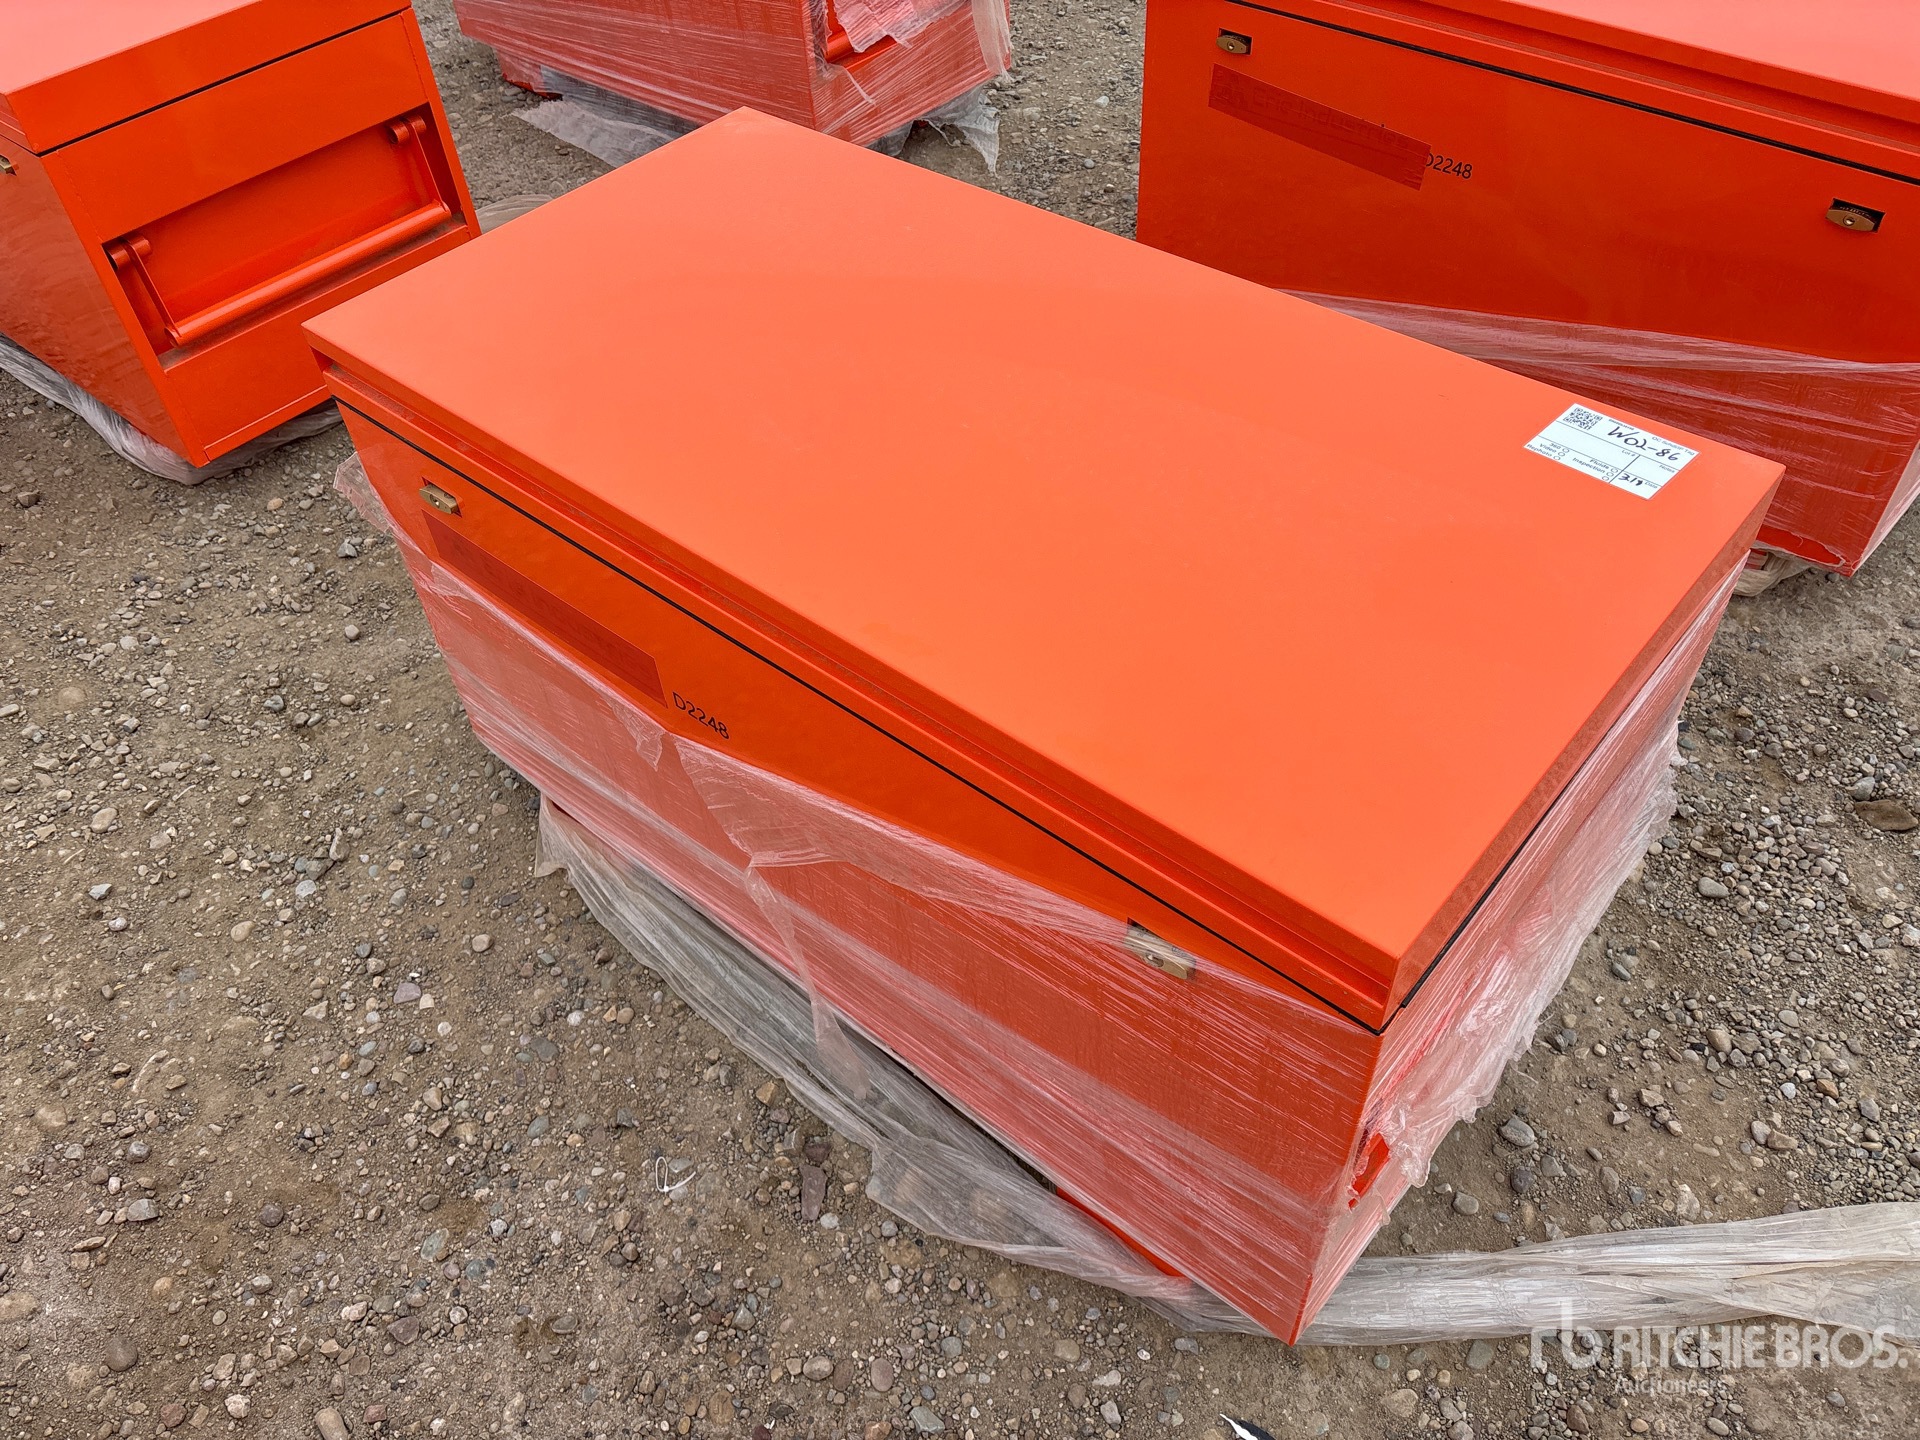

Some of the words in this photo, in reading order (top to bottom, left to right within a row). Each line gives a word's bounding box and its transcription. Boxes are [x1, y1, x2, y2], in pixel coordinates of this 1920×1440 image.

[1526, 443, 1553, 457] Rephoto
[1539, 443, 1557, 453] Video
[1572, 457, 1606, 474] Inspection
[1589, 459, 1610, 470] Fluids
[1659, 464, 1675, 473] Notes
[1644, 481, 1658, 489] Date
[672, 691, 730, 740] D2248
